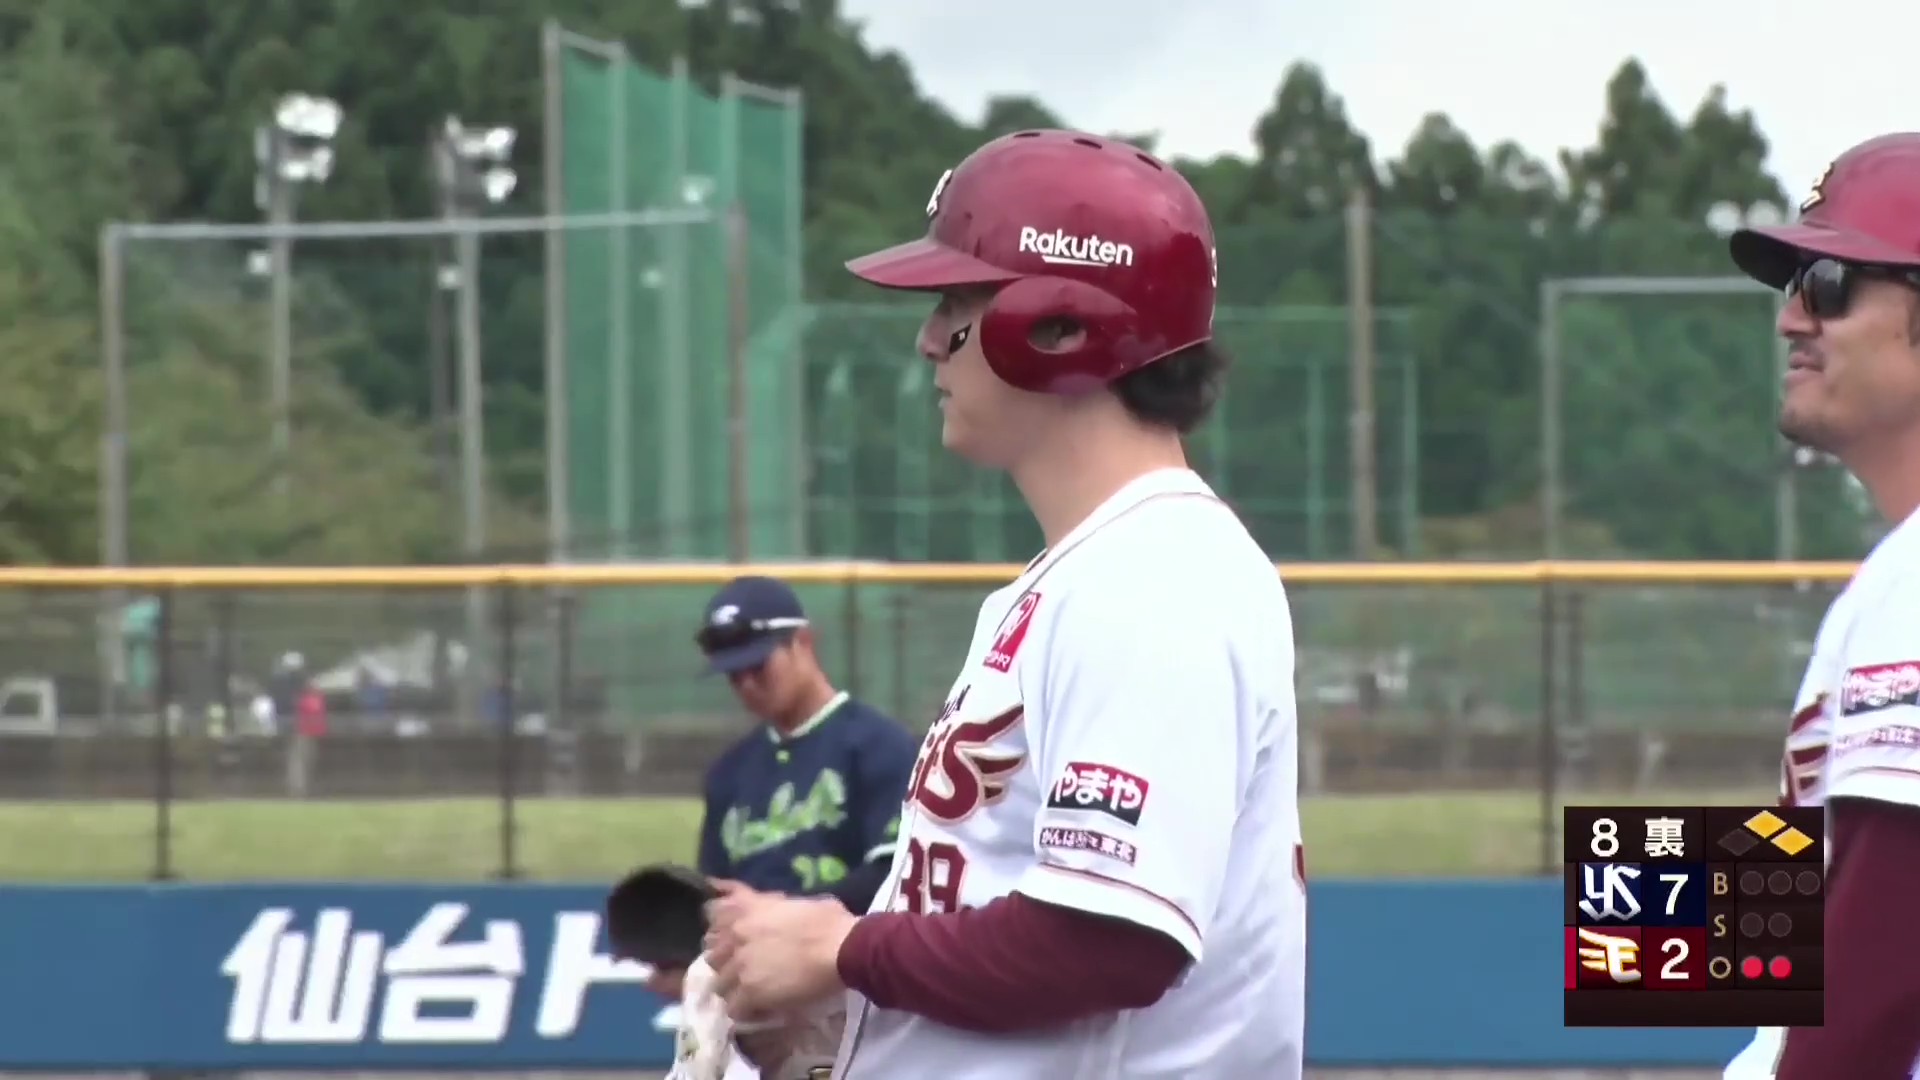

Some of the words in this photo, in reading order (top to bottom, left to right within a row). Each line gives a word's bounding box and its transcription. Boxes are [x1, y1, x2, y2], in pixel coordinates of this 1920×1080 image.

[1019, 225, 1133, 267] Rakuten
[1054, 766, 1142, 811] やまや
[899, 838, 966, 914] 39
[220, 901, 682, 1046] 仙台ト
